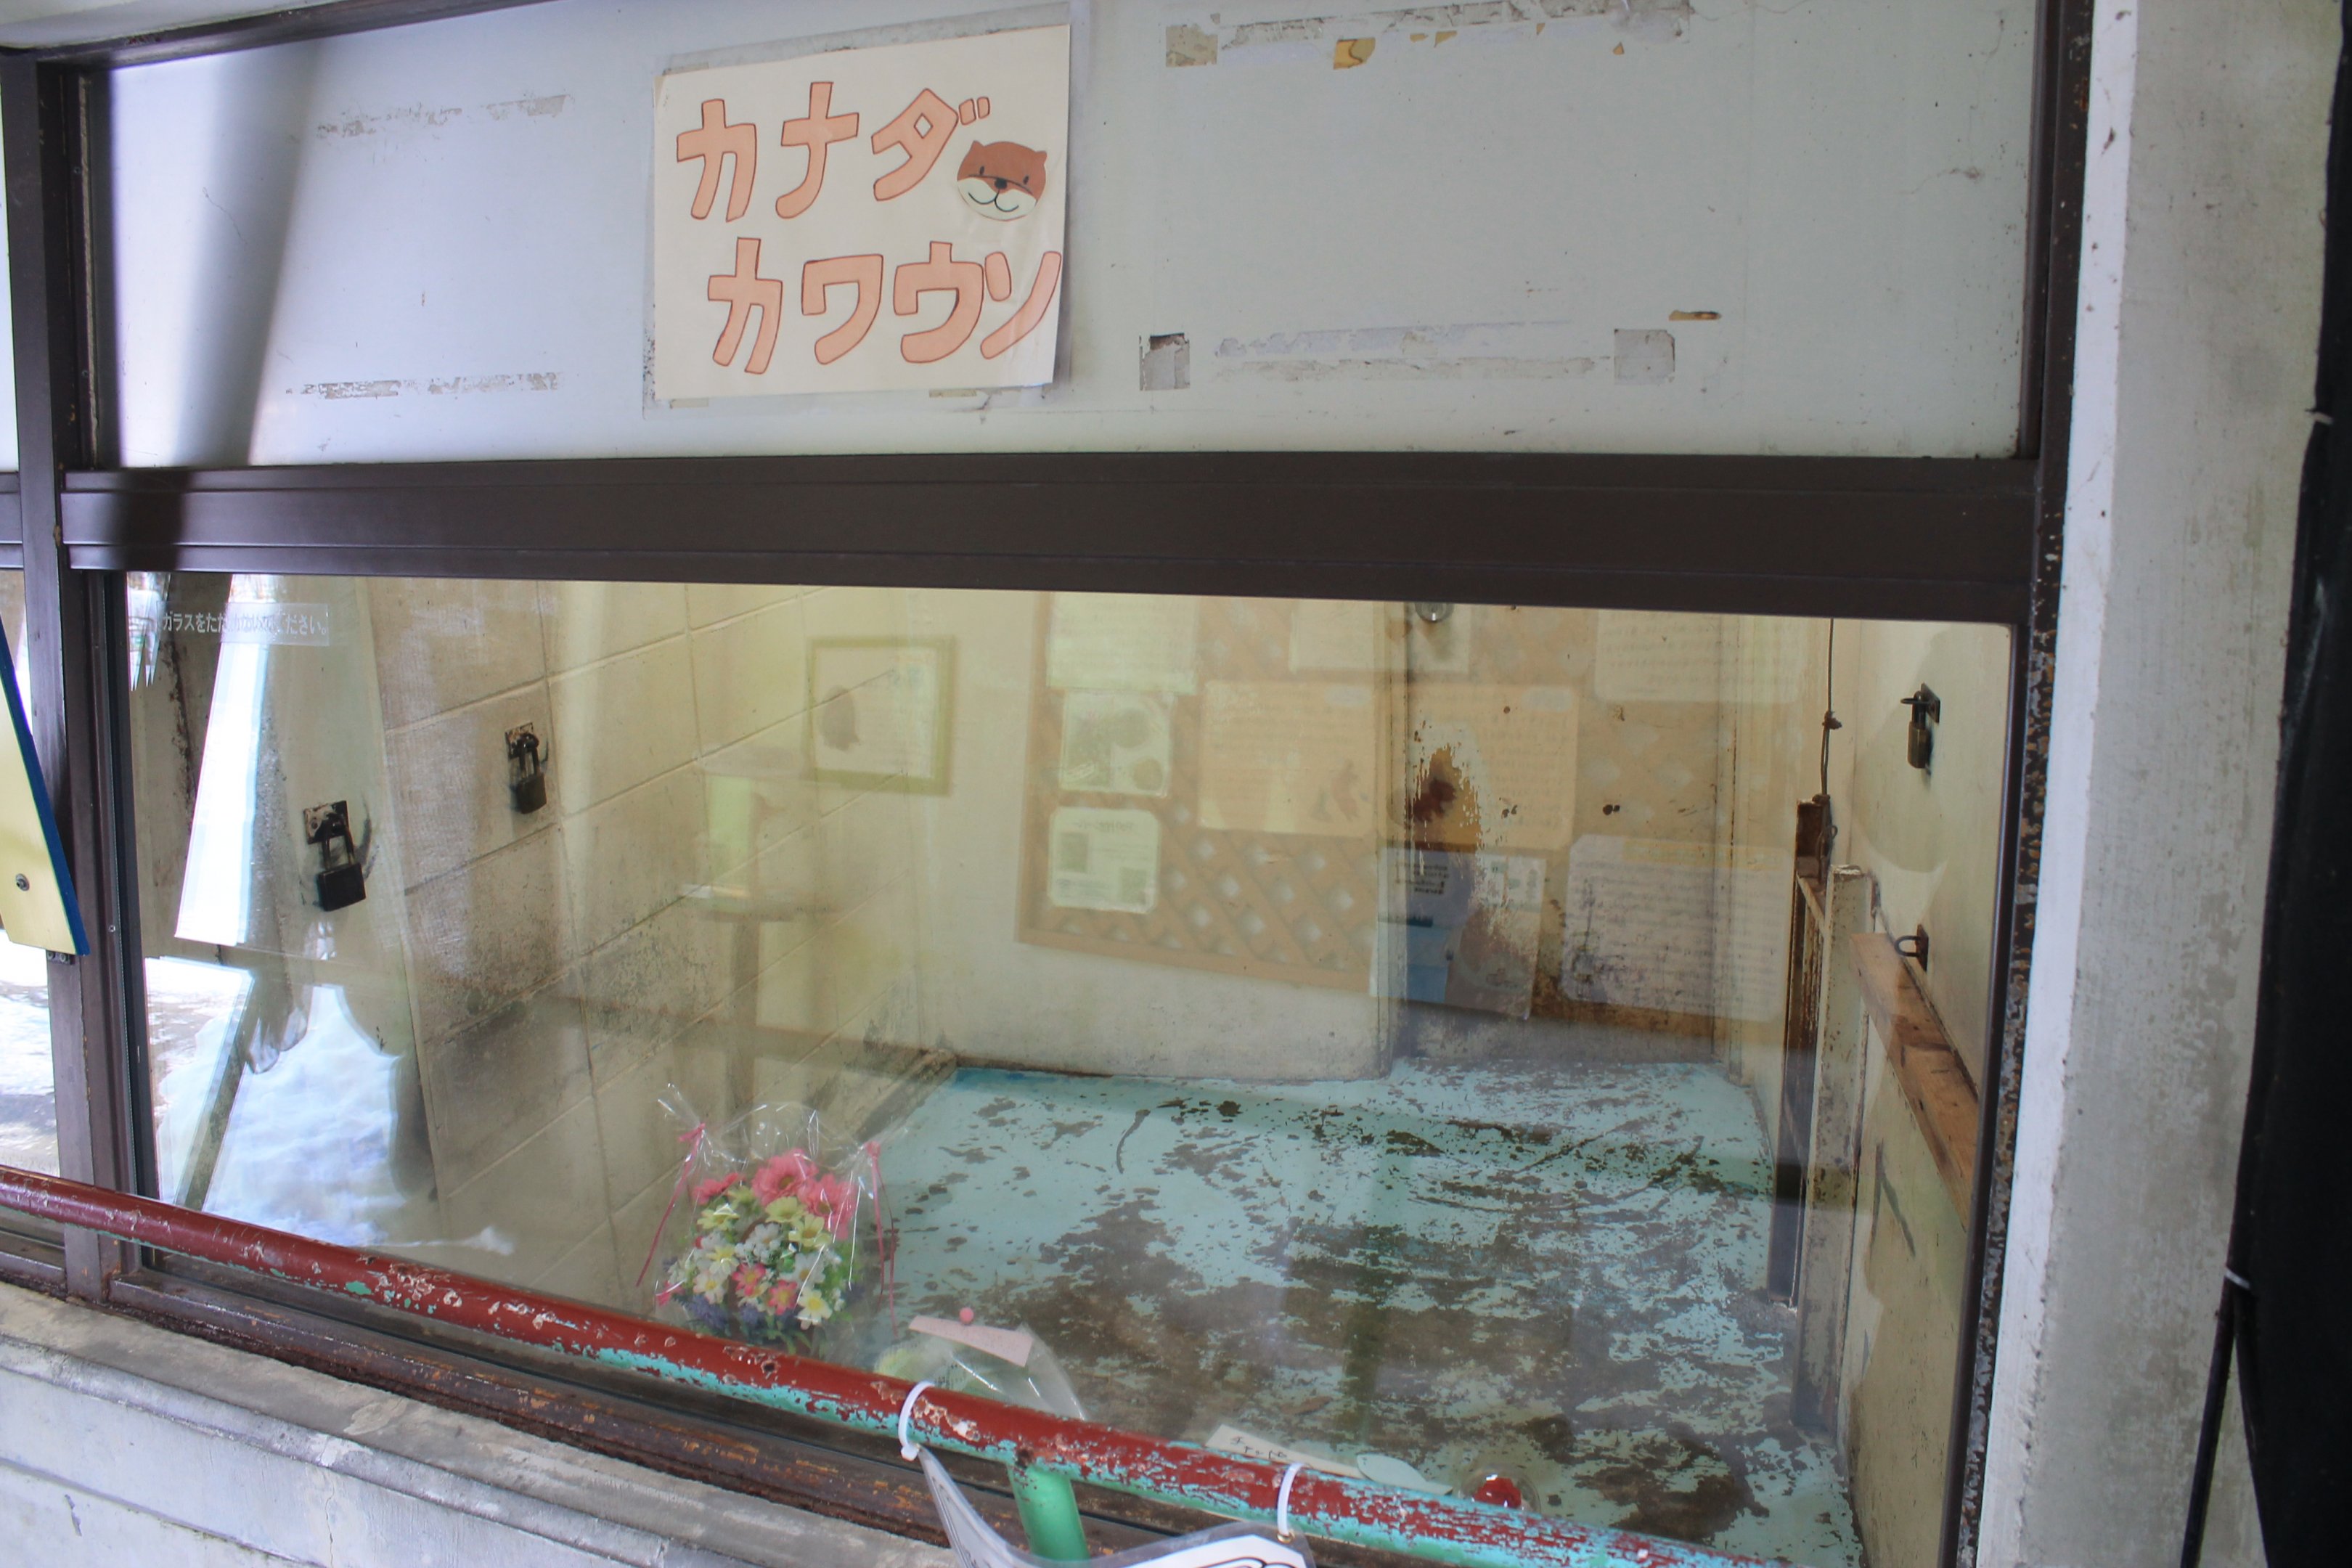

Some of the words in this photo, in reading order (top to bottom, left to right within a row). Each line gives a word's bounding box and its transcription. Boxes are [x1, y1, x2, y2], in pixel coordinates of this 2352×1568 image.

[677, 82, 990, 222] カナダ
[707, 237, 1061, 374] カワウソ
